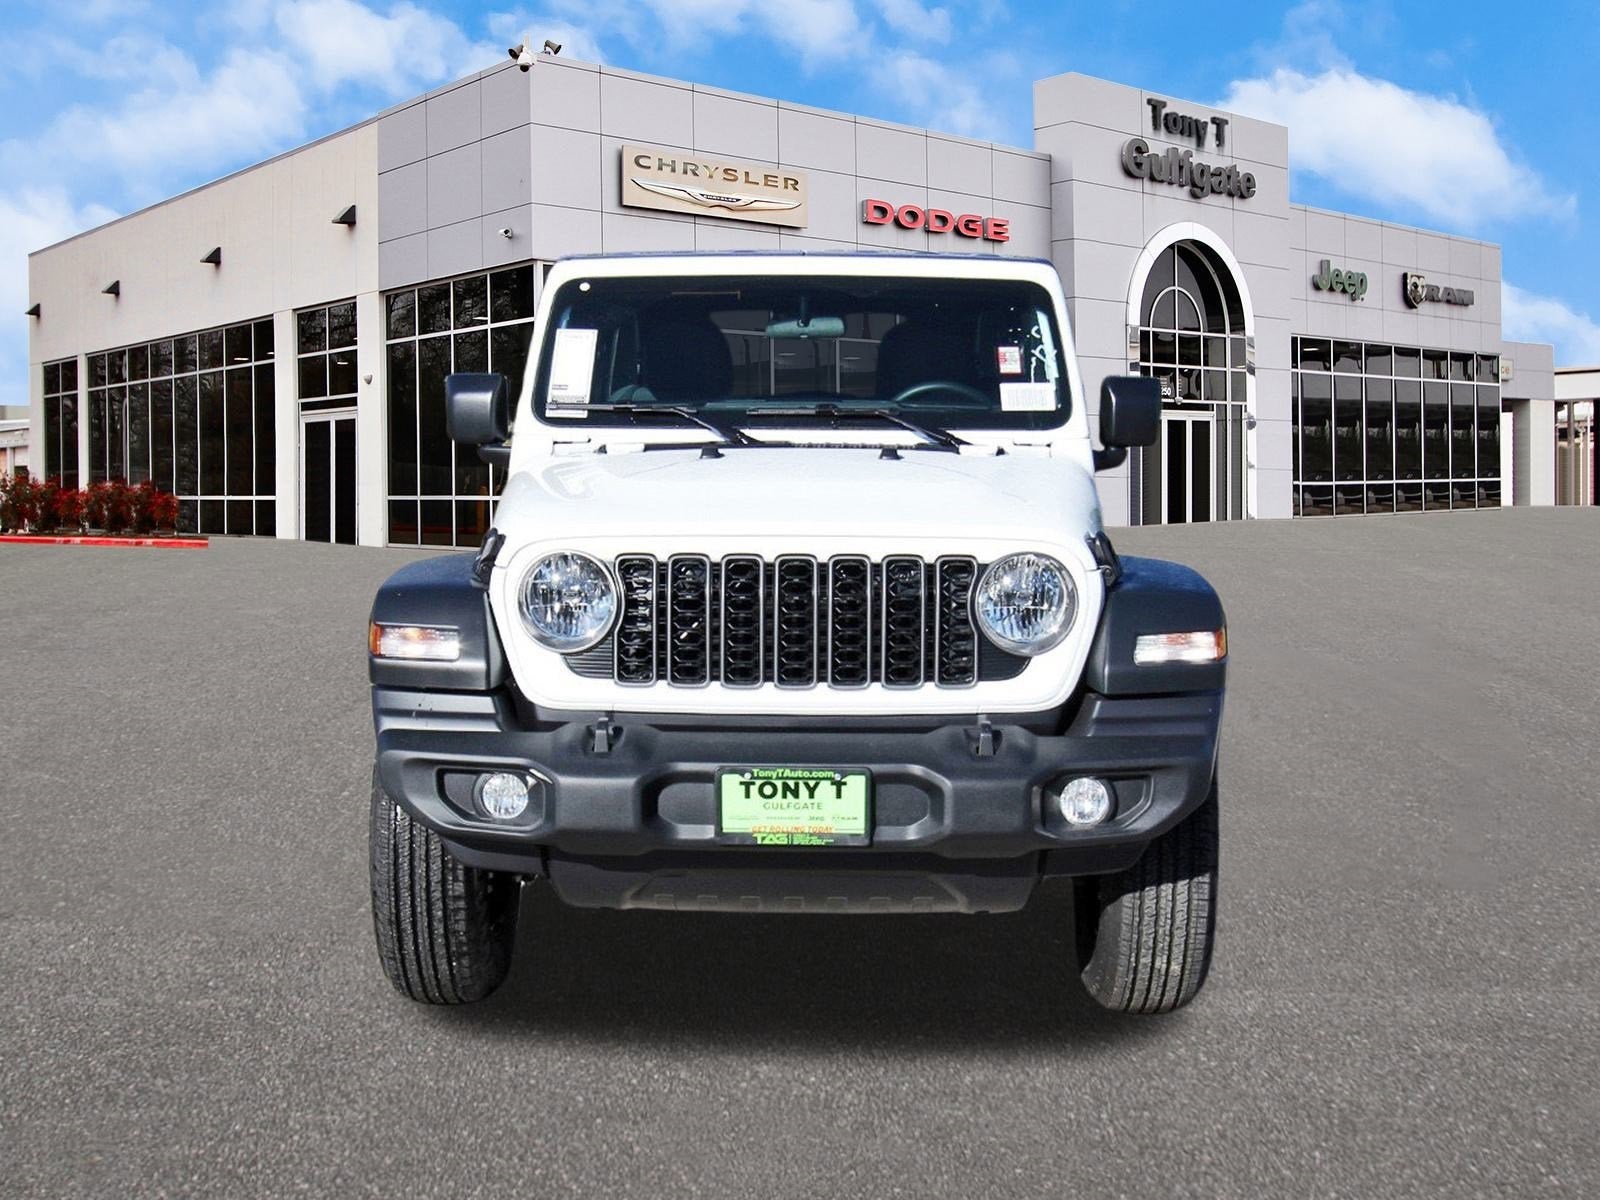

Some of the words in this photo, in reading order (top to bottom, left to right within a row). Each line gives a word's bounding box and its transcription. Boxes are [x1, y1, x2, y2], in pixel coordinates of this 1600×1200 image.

[1147, 98, 1208, 148] Tony
[1210, 116, 1229, 147] T
[633, 154, 800, 192] CHRYSLER
[1121, 137, 1257, 199] Gulfgate
[863, 198, 1010, 242] DODGE
[1313, 259, 1368, 301] Jeep
[1425, 284, 1475, 306] RAM
[752, 768, 835, 780] TonyTAuto.com
[739, 781, 821, 800] TONY
[830, 781, 847, 799] T
[762, 802, 824, 811] GULFGATE
[769, 825, 805, 834] ROLLING
